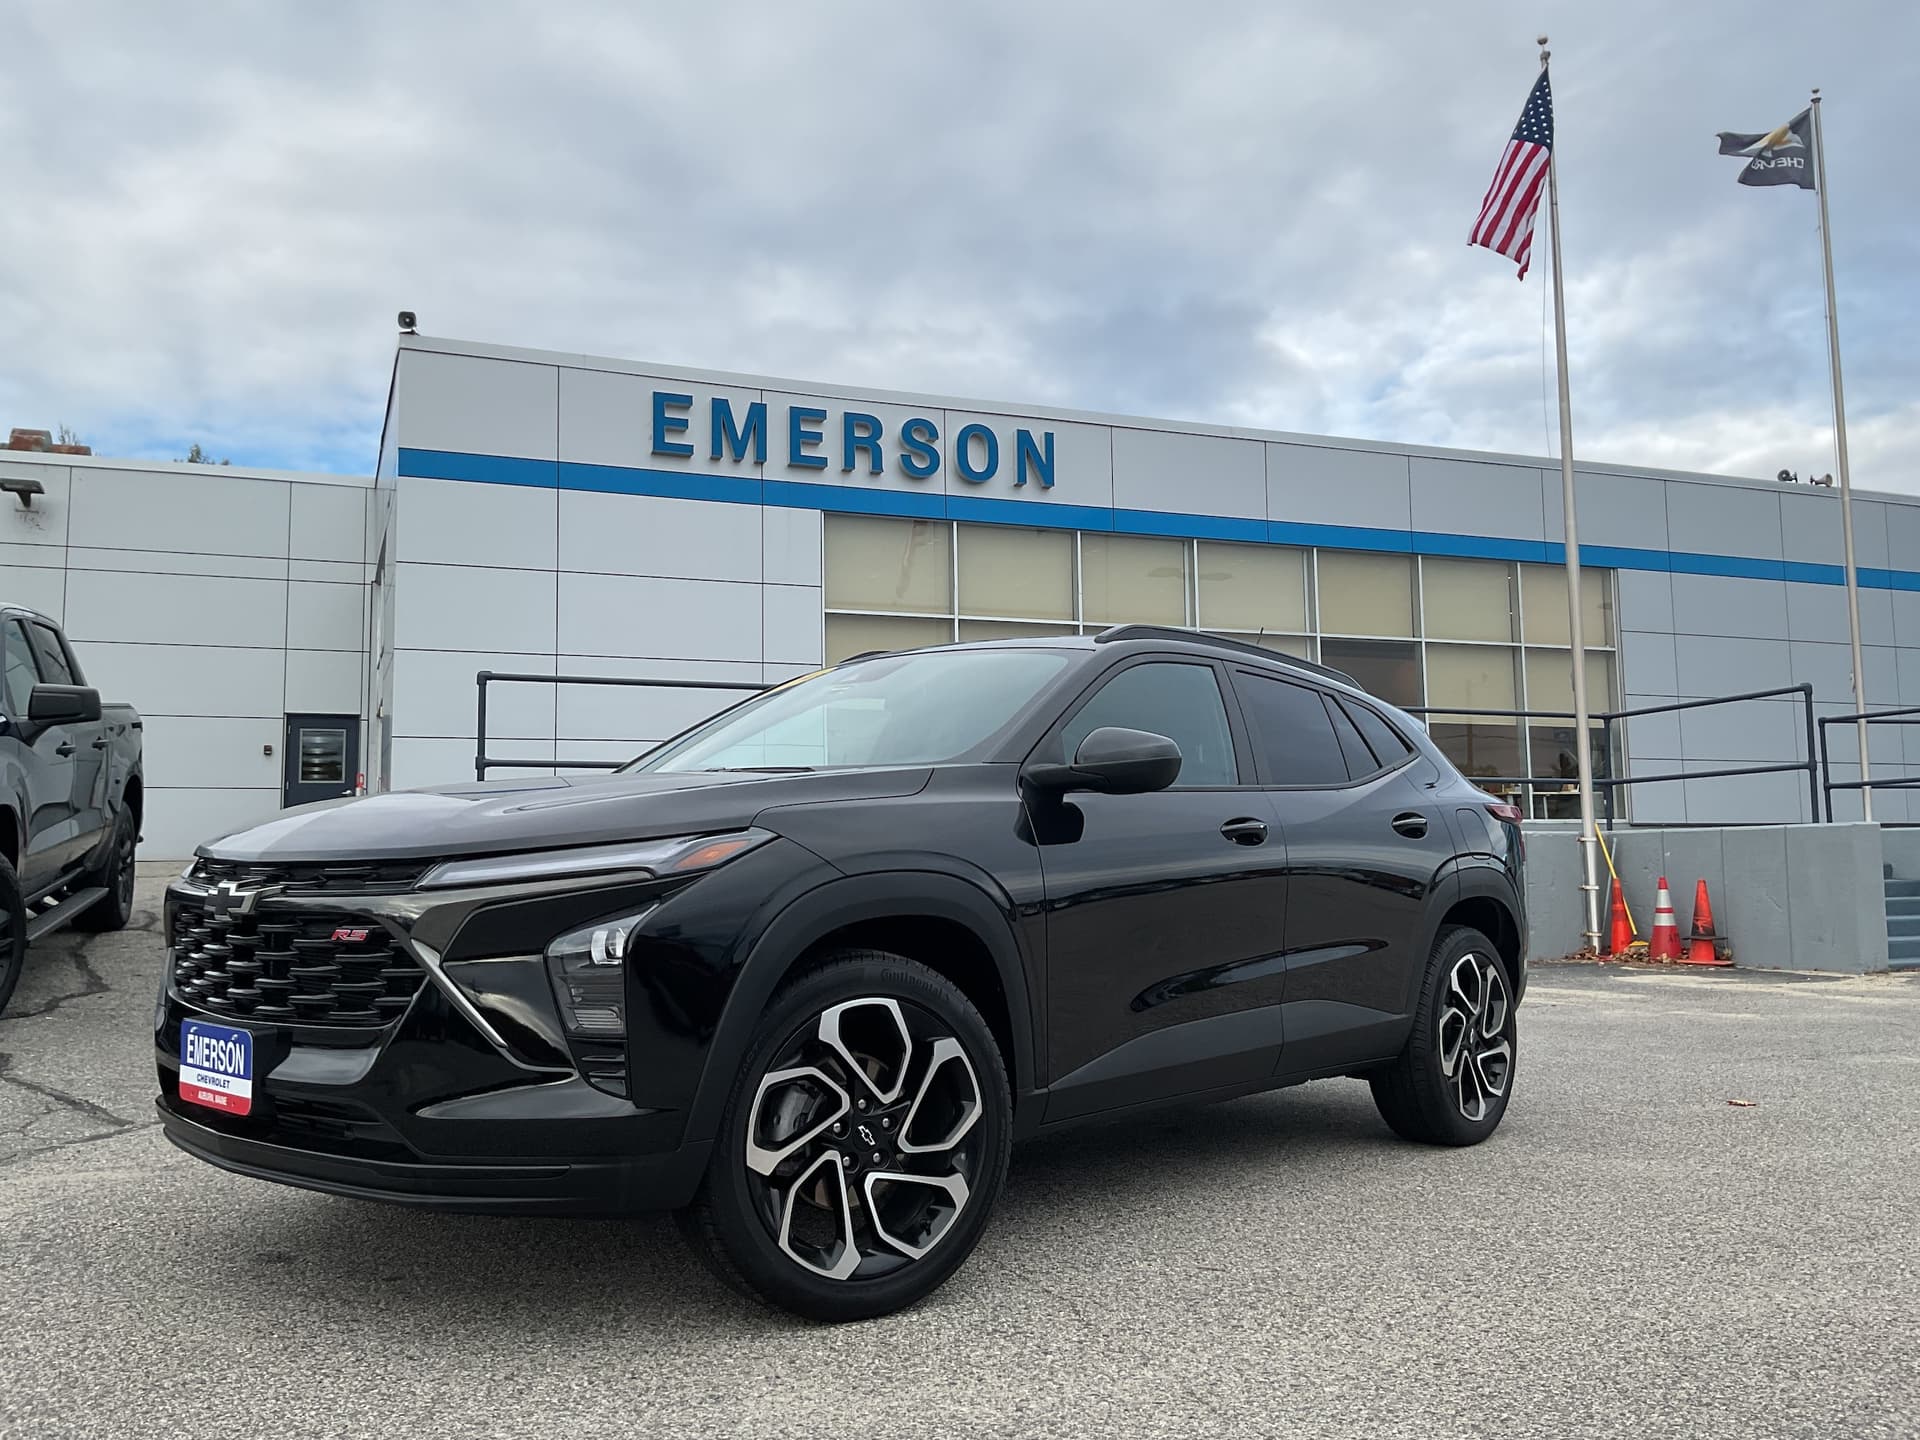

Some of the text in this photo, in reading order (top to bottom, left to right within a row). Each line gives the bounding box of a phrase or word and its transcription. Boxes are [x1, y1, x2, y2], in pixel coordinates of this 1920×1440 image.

[651, 391, 1055, 489] EMERSON
[331, 929, 369, 941] RS
[187, 1033, 245, 1075] EMERSON
[197, 1074, 230, 1088] CHEVROLET
